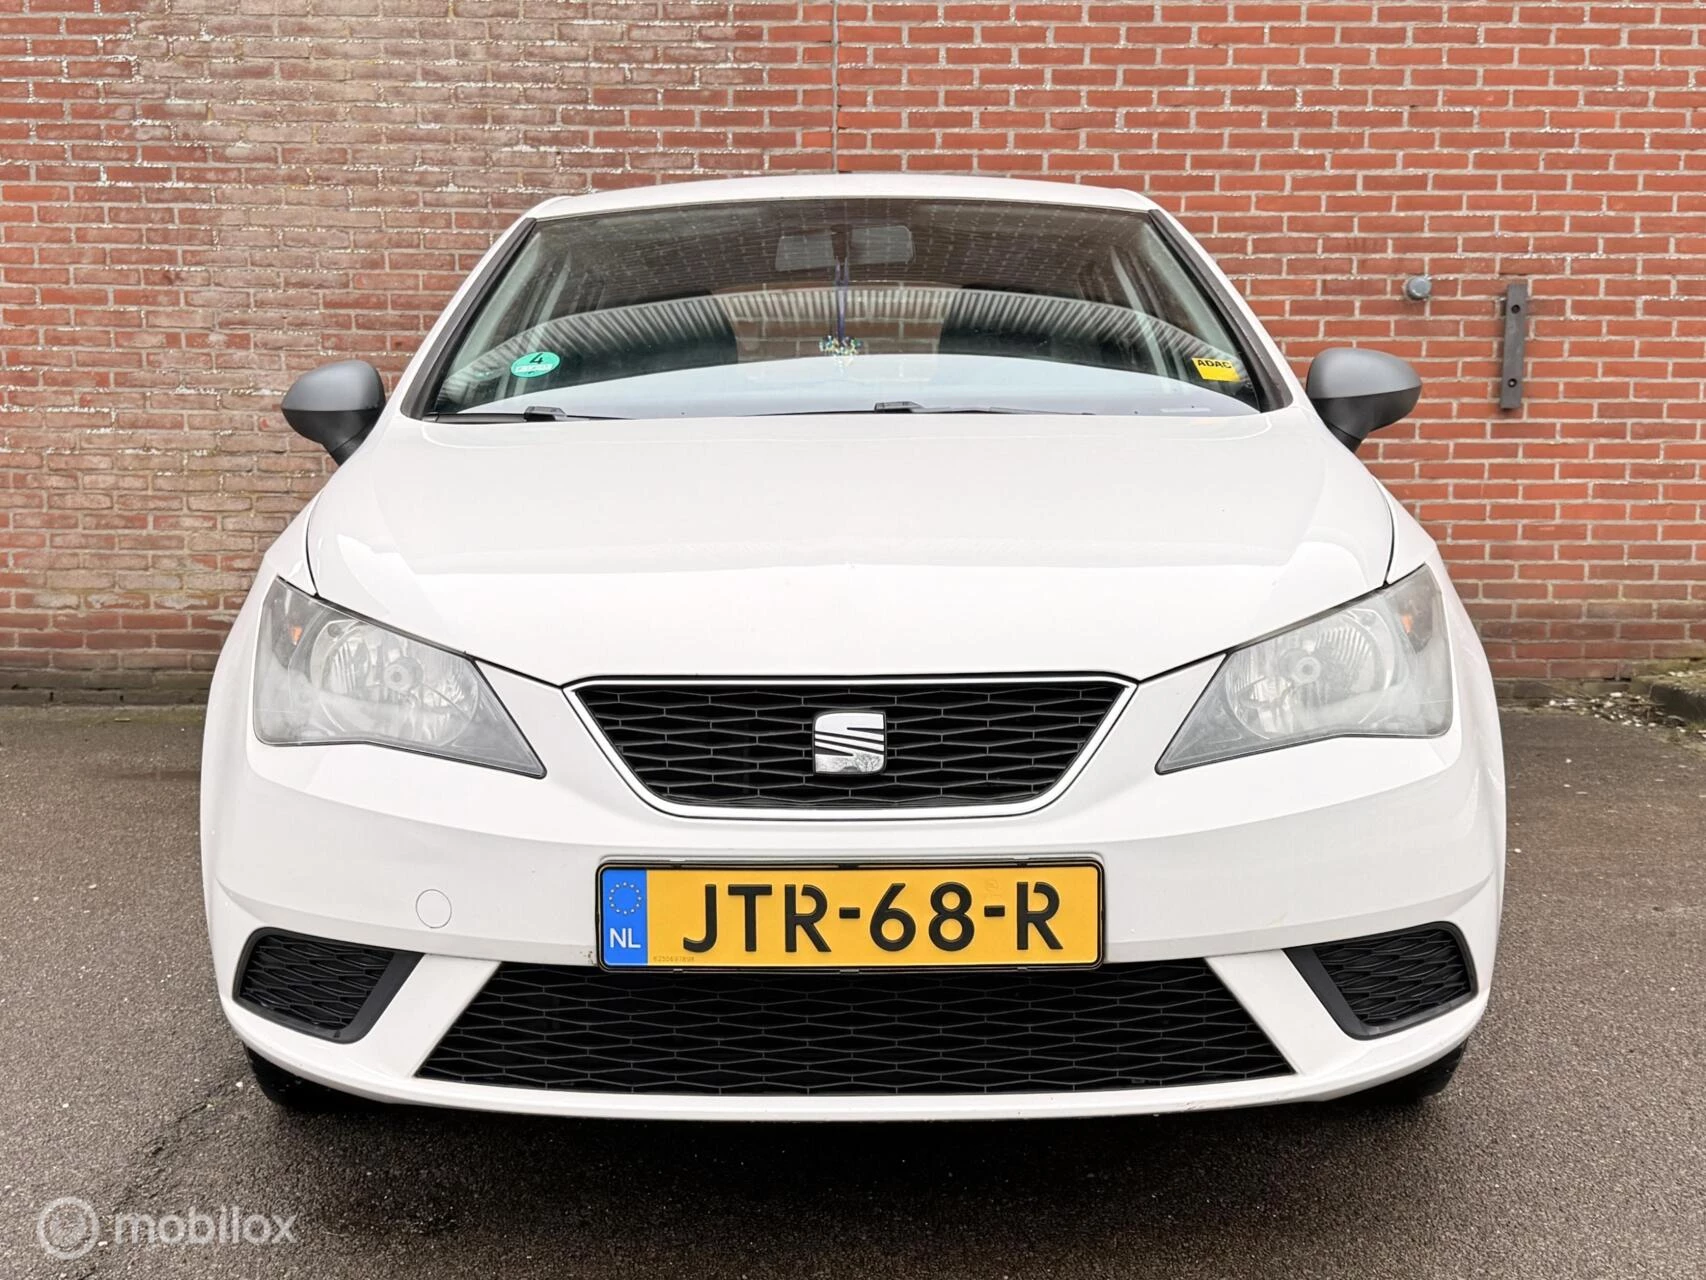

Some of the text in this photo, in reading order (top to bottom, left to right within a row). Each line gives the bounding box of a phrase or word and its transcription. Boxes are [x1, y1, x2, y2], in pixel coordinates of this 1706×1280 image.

[529, 352, 544, 364] 4
[1197, 359, 1232, 368] ADAC
[682, 881, 1064, 953] JTR-68-R
[609, 927, 641, 949] NL
